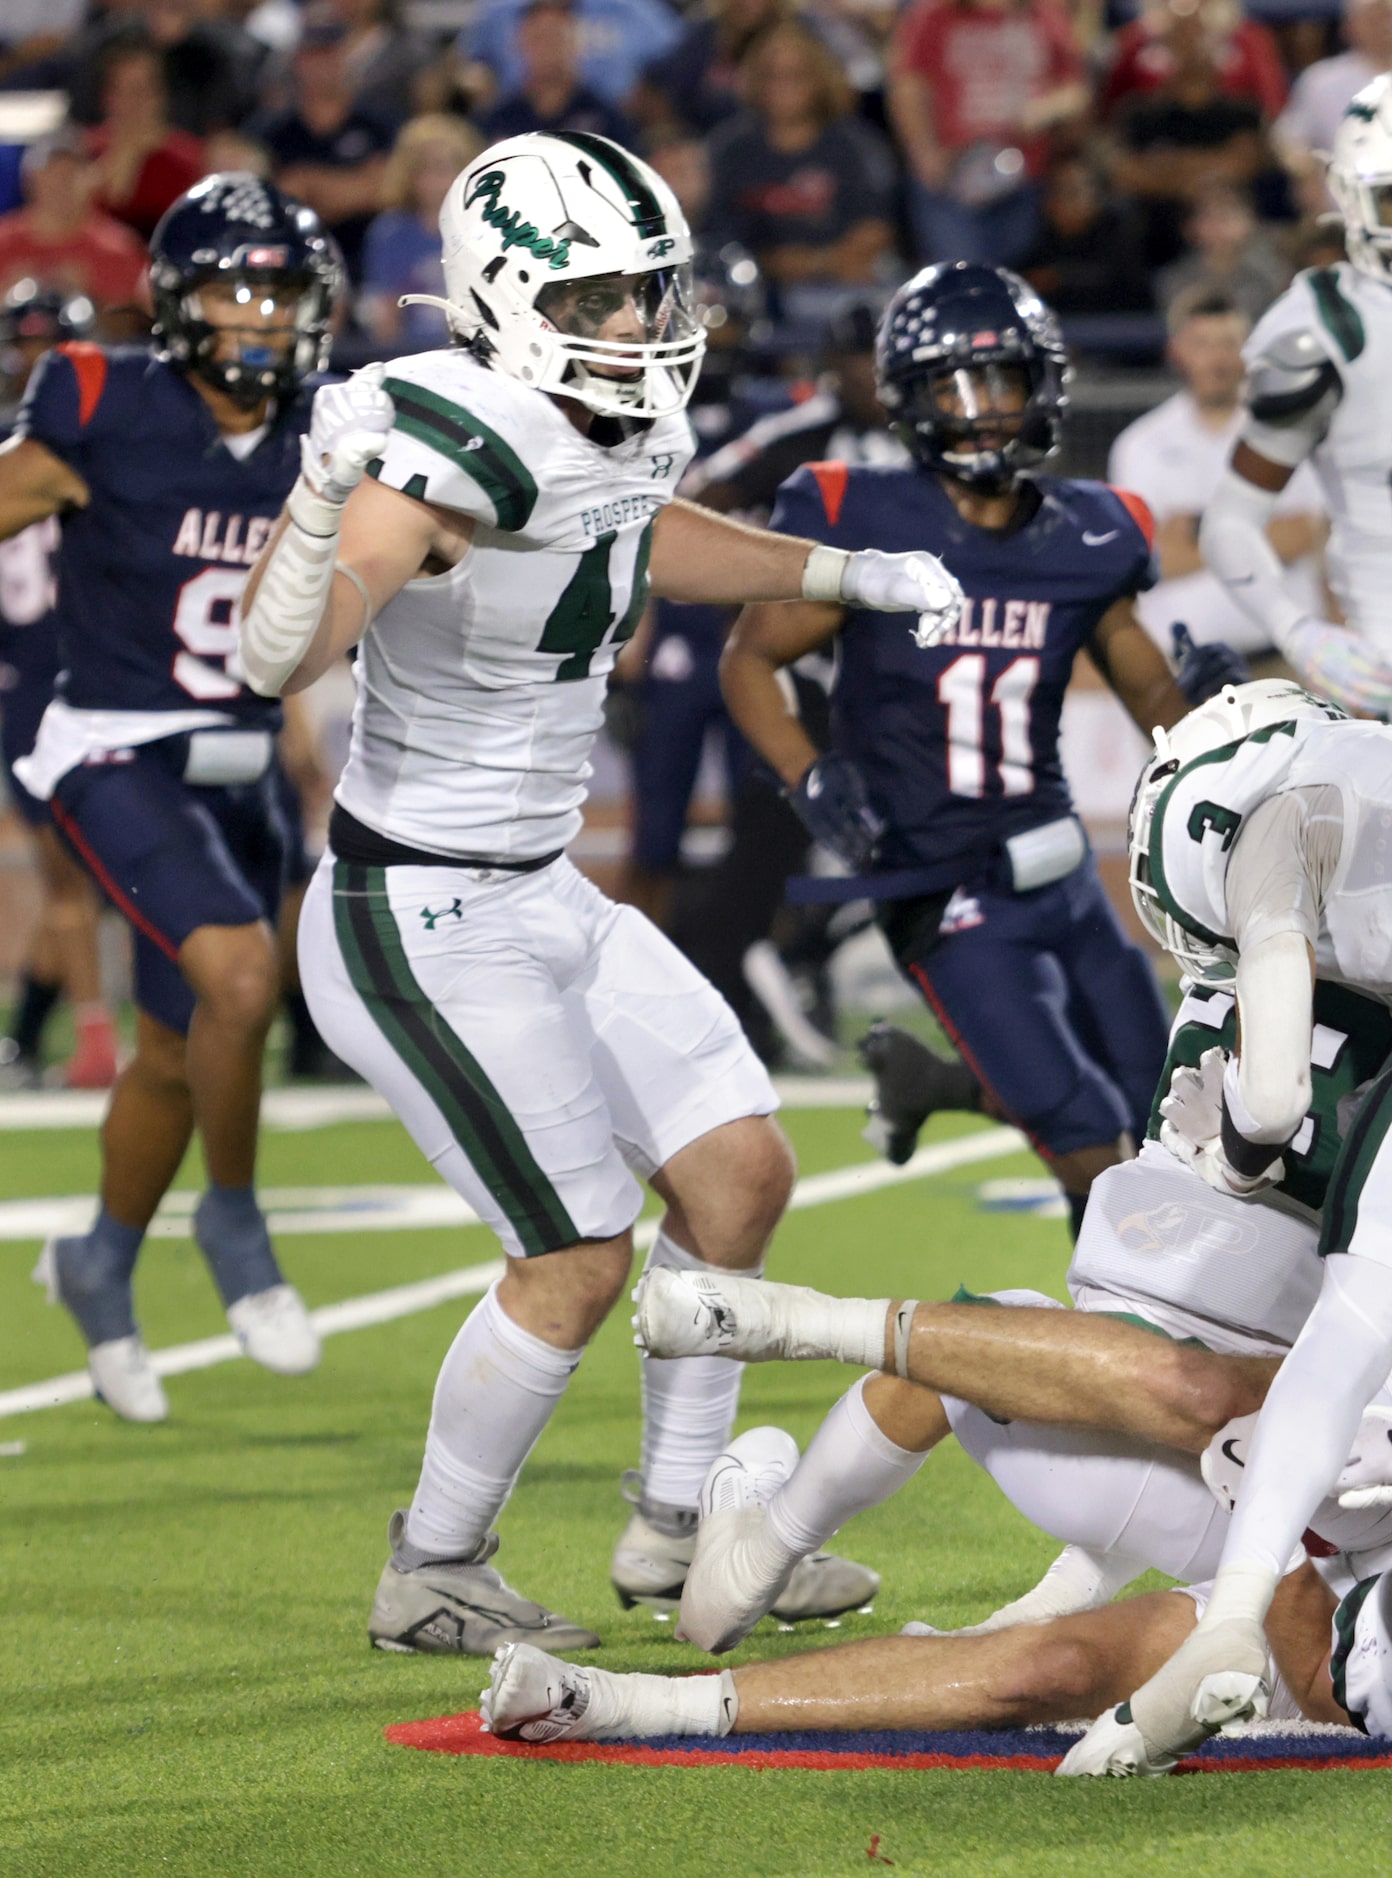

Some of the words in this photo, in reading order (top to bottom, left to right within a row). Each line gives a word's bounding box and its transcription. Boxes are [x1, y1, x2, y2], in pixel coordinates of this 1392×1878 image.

[464, 171, 571, 270] Prosper
[172, 507, 275, 565] ALLE
[172, 566, 247, 701] 9
[936, 653, 1041, 798] 11
[1186, 799, 1243, 852] 3
